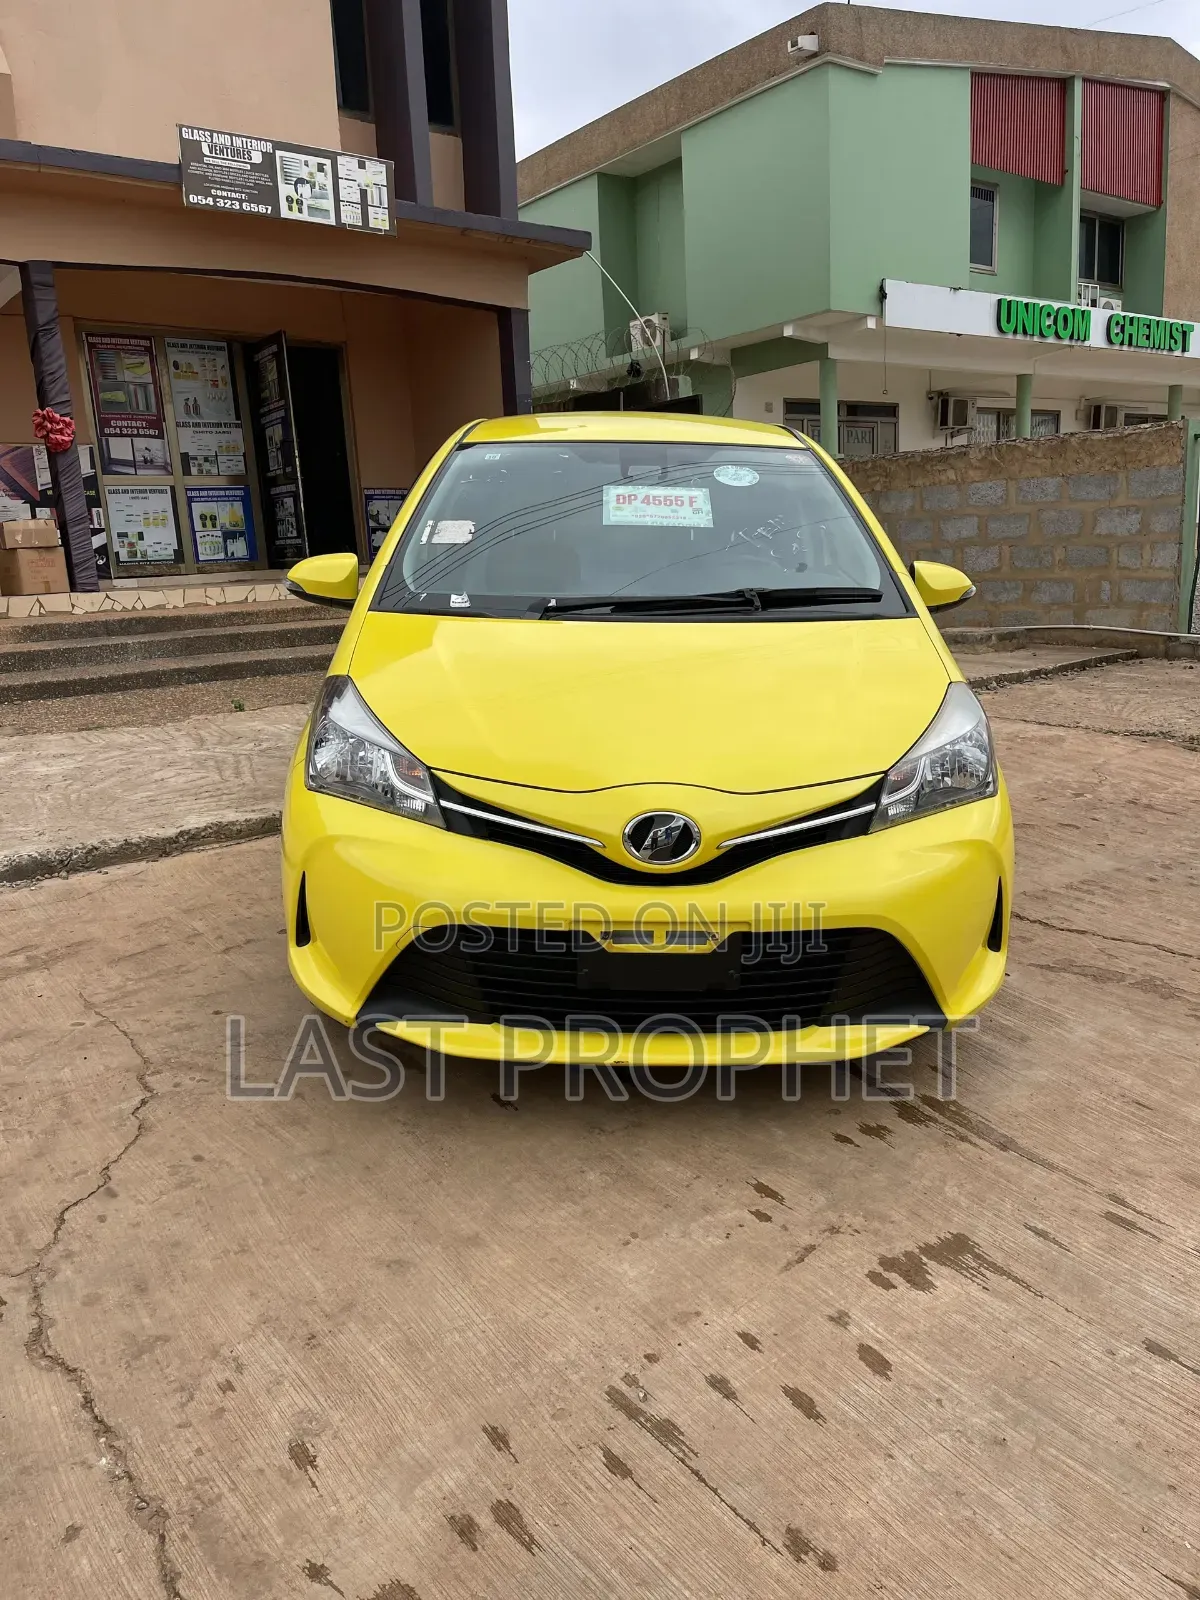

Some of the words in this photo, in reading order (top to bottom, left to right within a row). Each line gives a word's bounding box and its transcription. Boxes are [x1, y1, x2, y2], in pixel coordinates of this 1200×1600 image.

[182, 128, 212, 143] GLASS
[213, 133, 232, 146] AND
[233, 136, 273, 154] INTERIOR
[207, 143, 253, 162] VENTURES
[189, 194, 214, 206] 054
[216, 198, 240, 210] 323
[242, 202, 272, 214] 6567
[211, 189, 248, 200] CONTACT:
[996, 298, 1092, 342] UNICOM
[1106, 313, 1194, 352] CHEMIST
[111, 420, 149, 428] CONTACT:
[615, 494, 638, 505] DP
[640, 494, 685, 507] 4555
[688, 496, 698, 508] F
